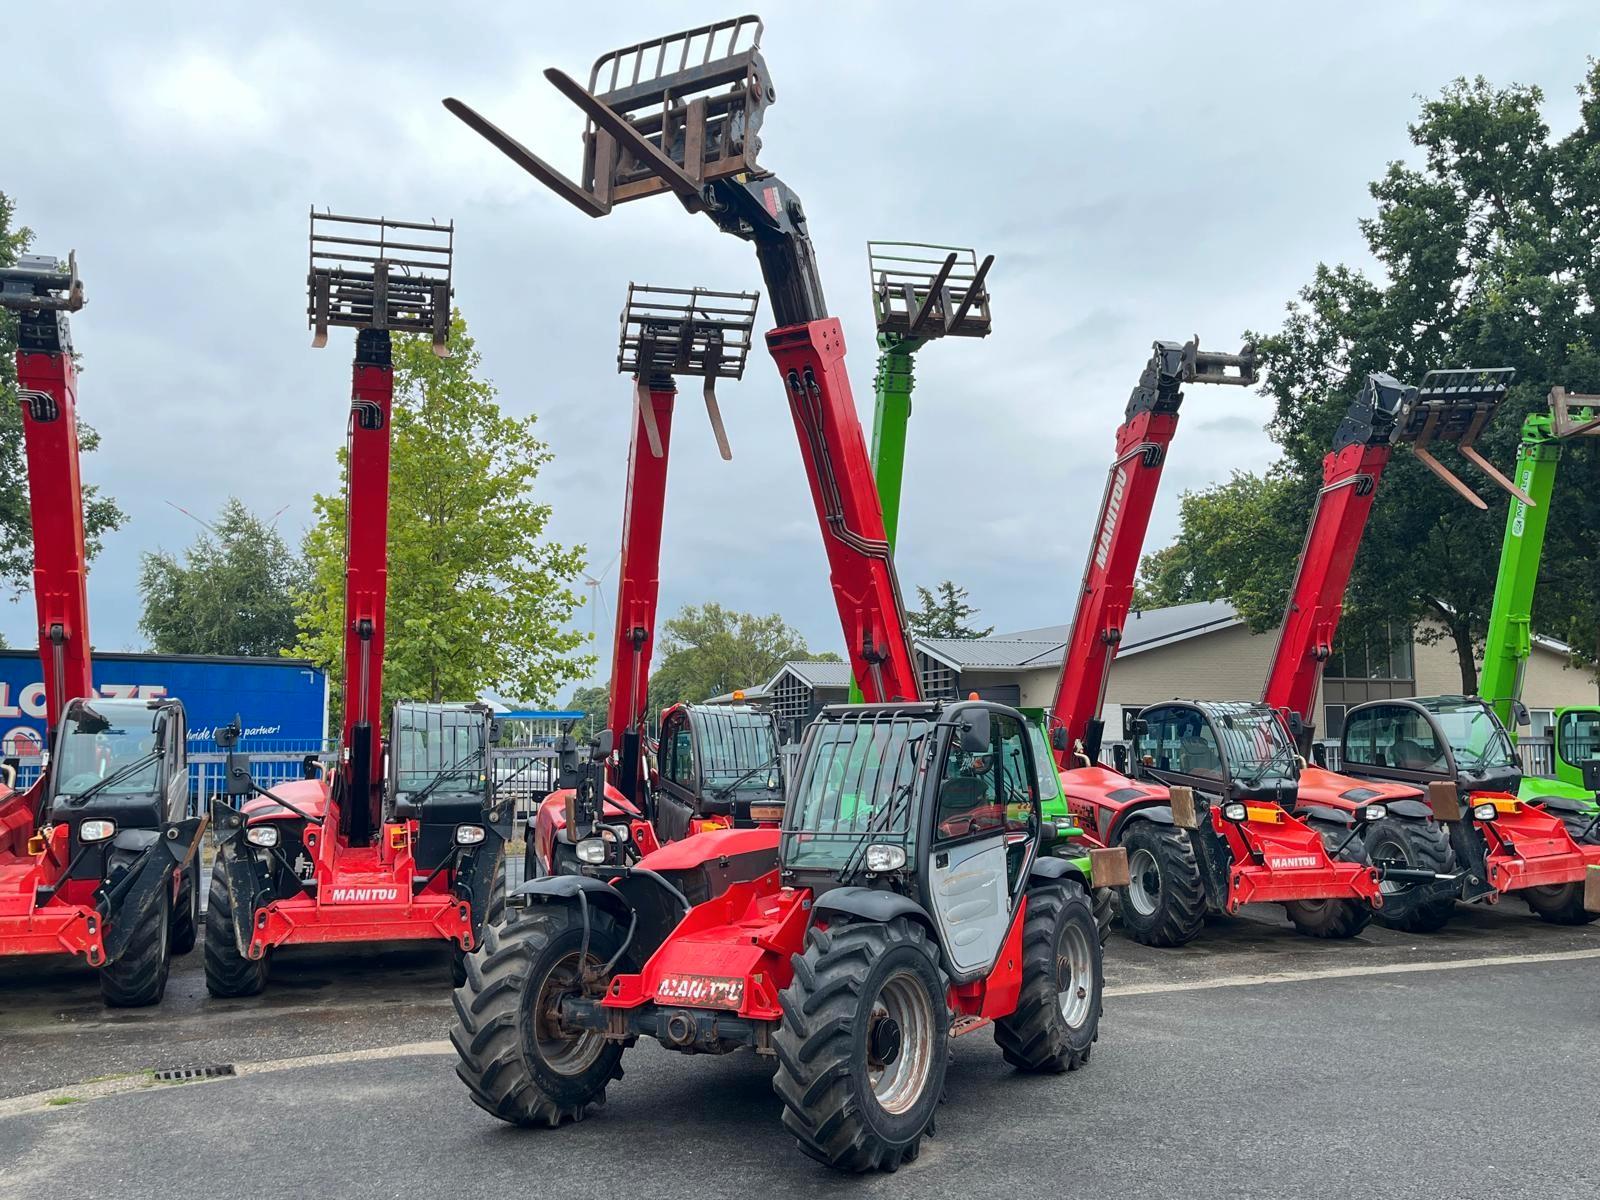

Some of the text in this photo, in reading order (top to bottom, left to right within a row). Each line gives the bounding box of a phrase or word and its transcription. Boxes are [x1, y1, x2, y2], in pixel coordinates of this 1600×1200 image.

[1095, 466, 1127, 570] MANITOU
[243, 725, 280, 739] partner!
[1271, 856, 1316, 868] MANITOU
[331, 888, 398, 901] MANITOU
